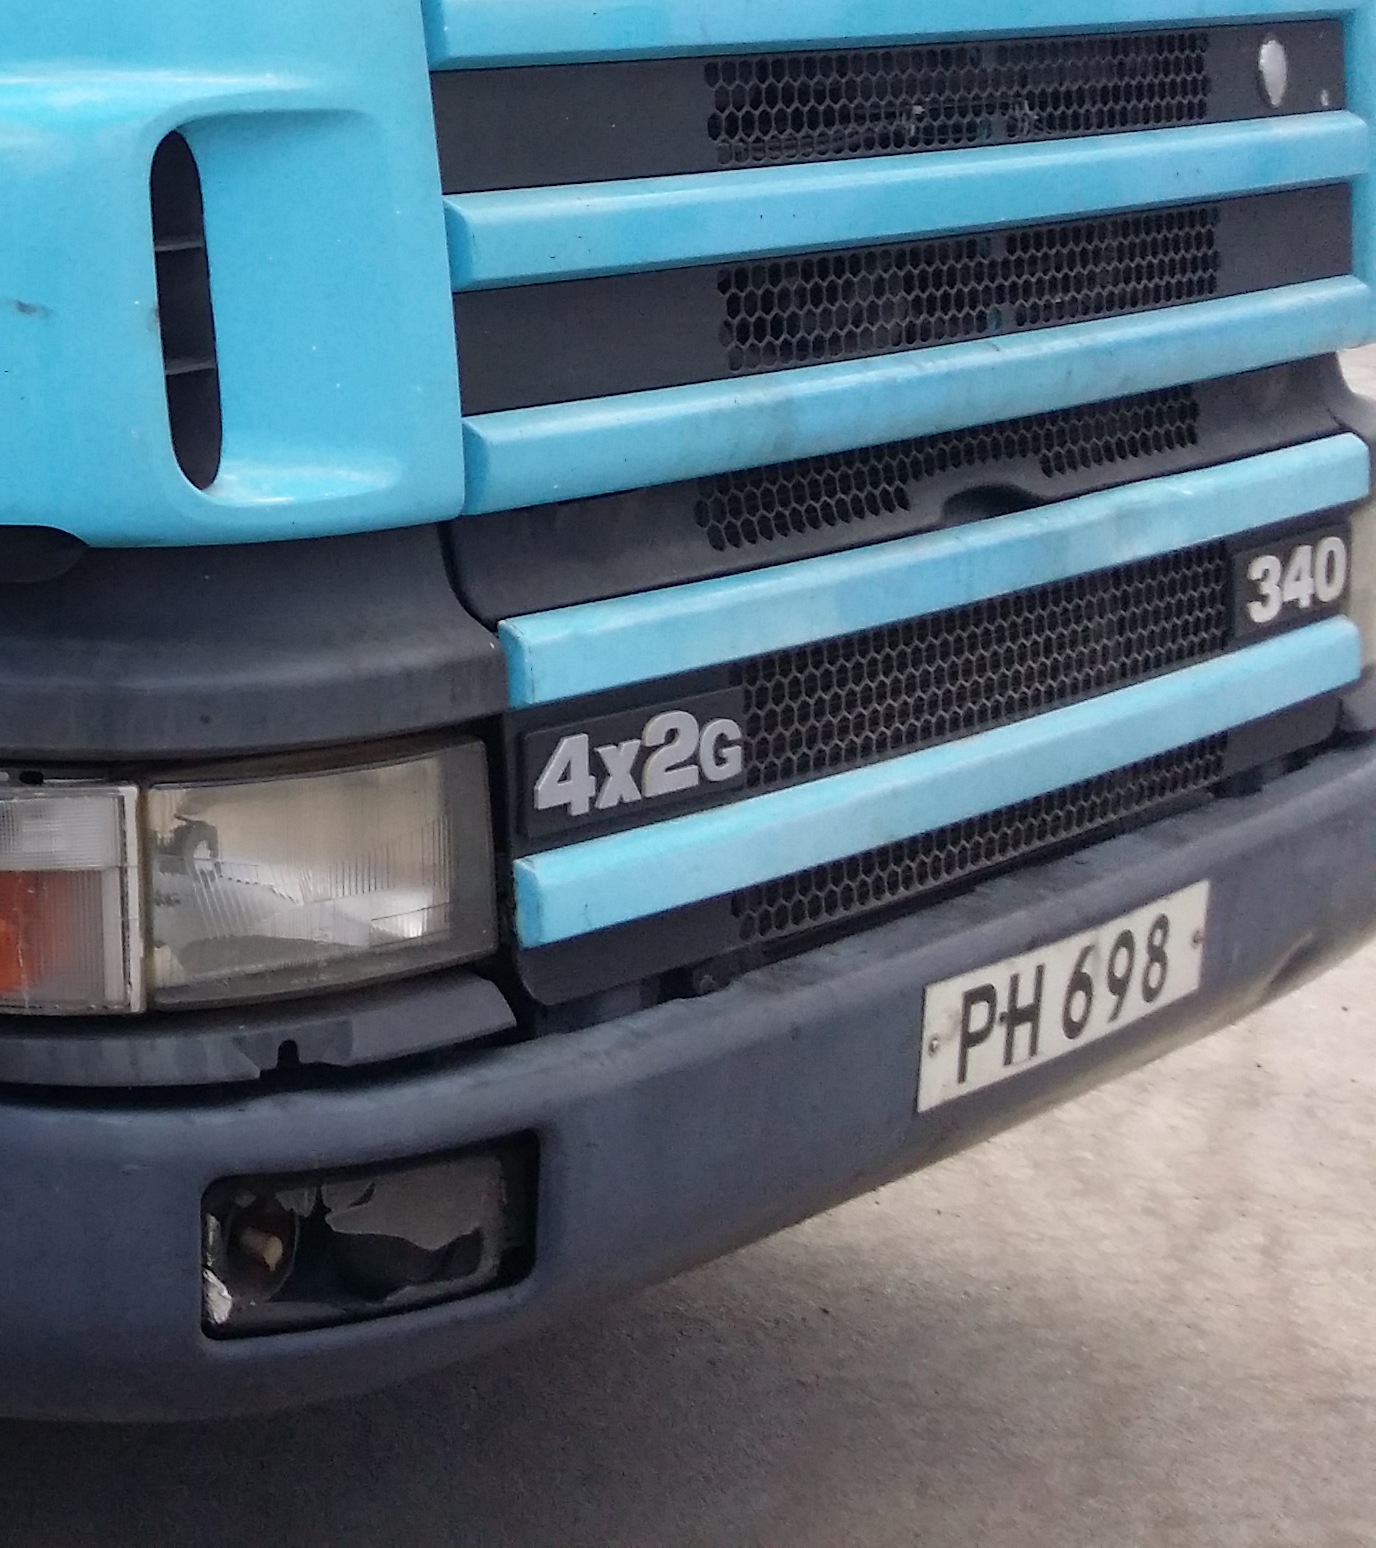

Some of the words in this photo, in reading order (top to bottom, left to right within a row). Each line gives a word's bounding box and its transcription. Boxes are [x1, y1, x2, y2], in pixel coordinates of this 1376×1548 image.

[1247, 536, 1347, 623] 340
[957, 963, 1046, 1084] PH
[1061, 913, 1170, 1040] 698
